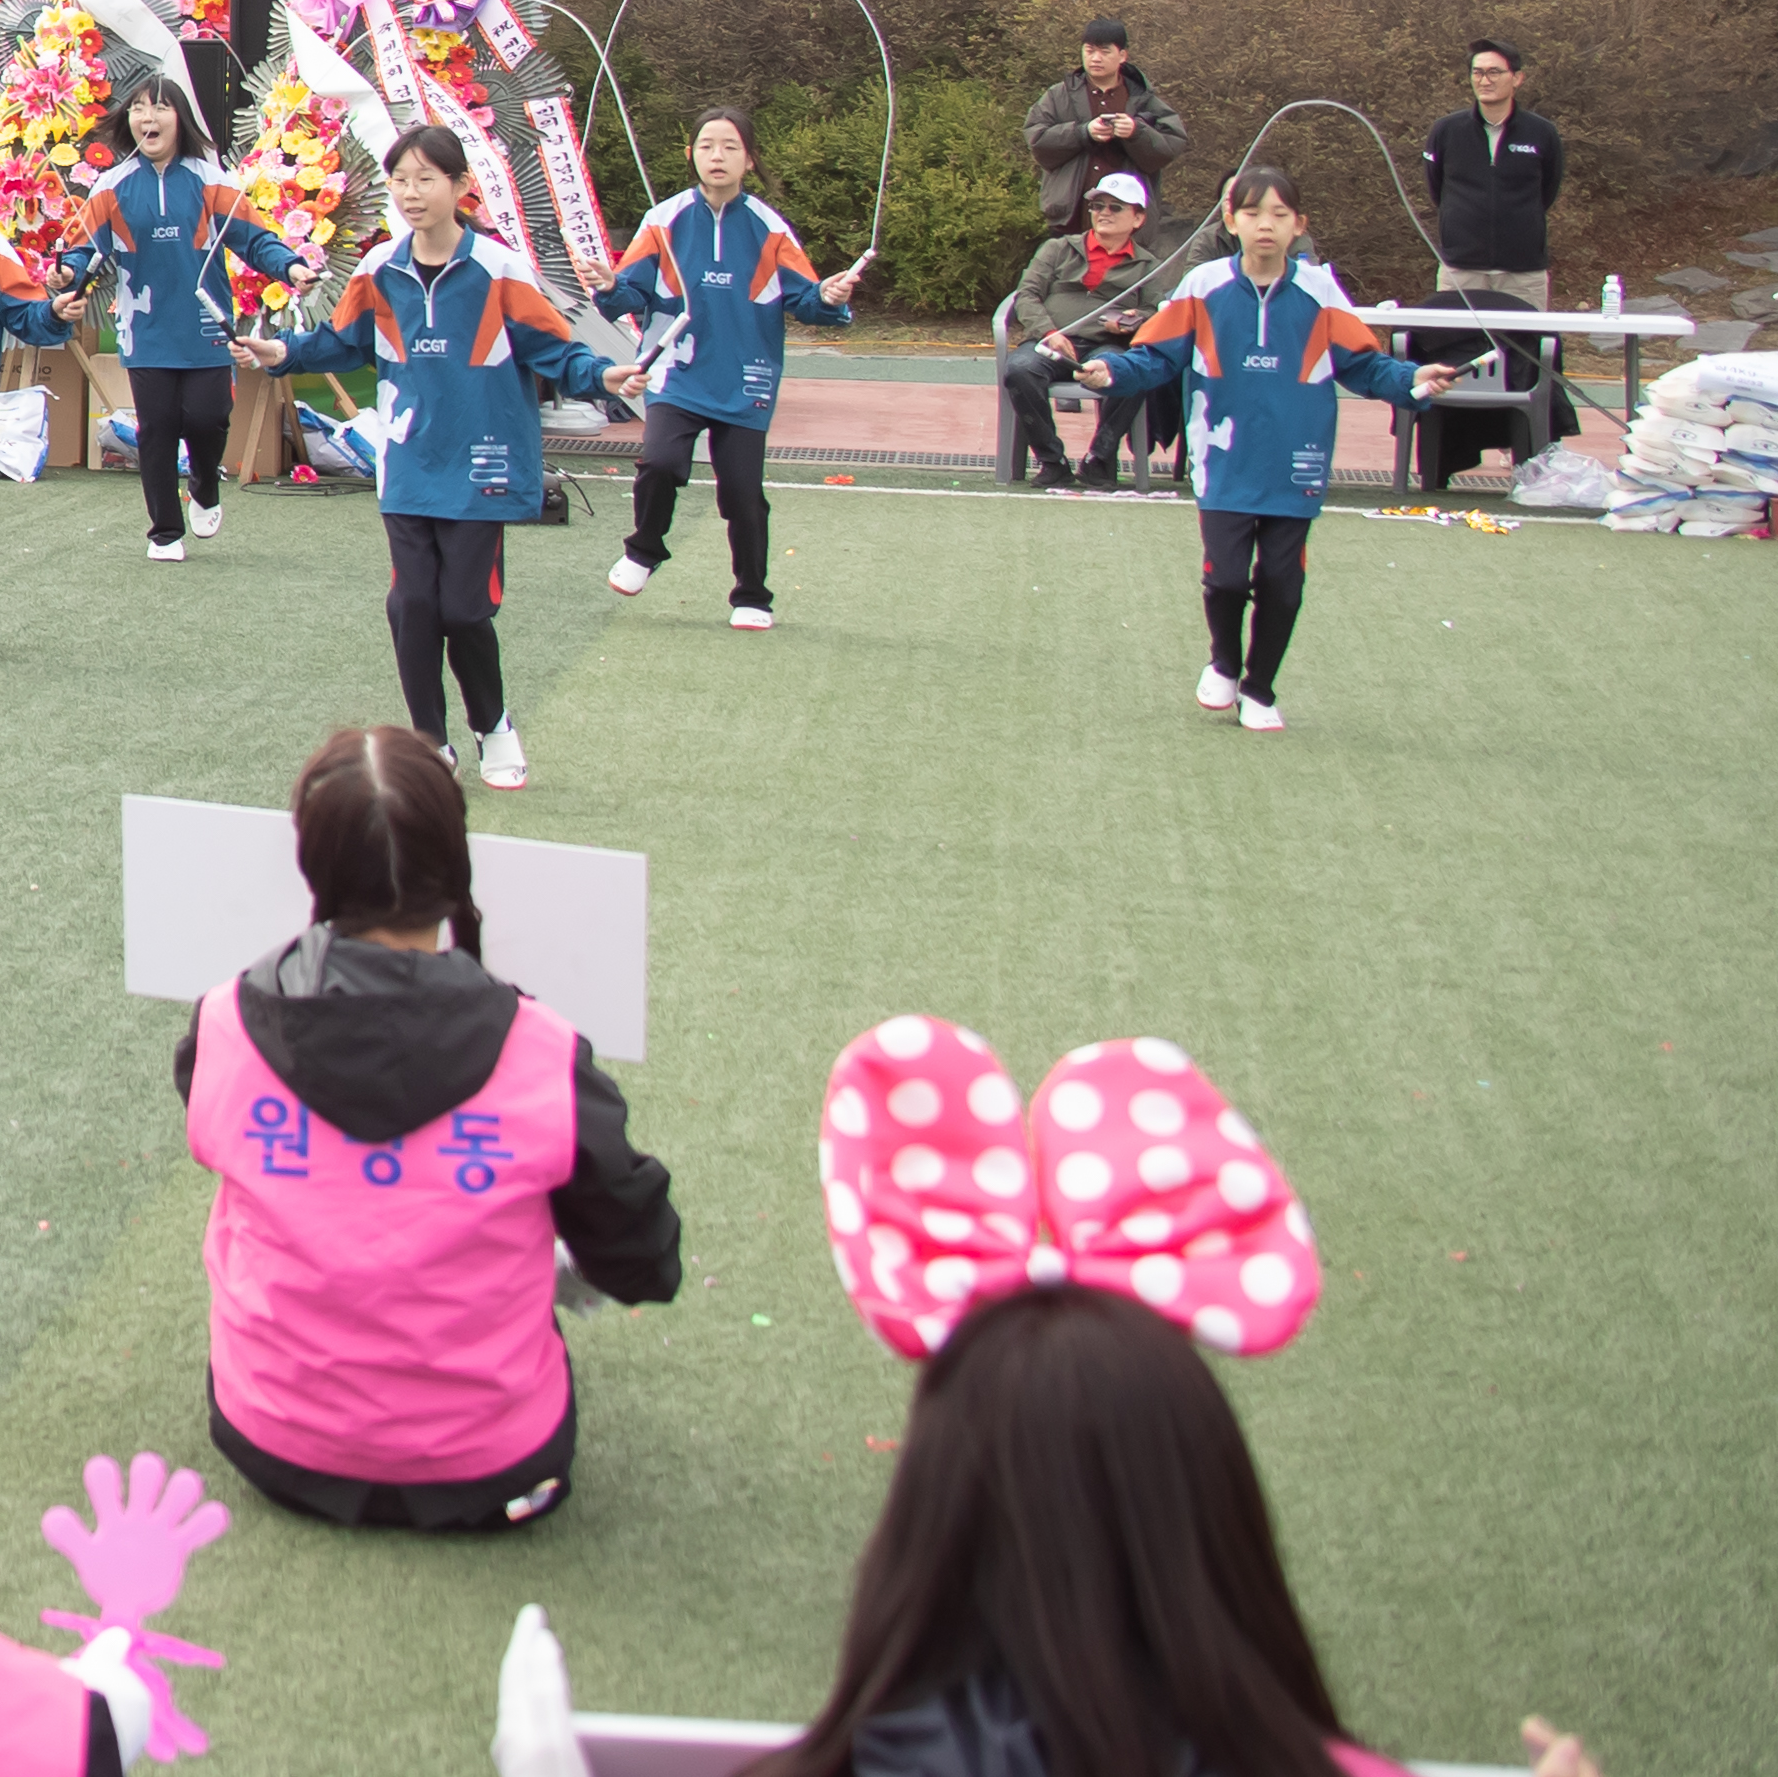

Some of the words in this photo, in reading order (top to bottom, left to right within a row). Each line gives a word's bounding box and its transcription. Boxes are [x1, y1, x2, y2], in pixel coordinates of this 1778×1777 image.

[152, 226, 180, 238] JCGT
[701, 271, 733, 285] JCGT
[411, 339, 448, 353] JCGT
[1242, 355, 1279, 369] JCGT
